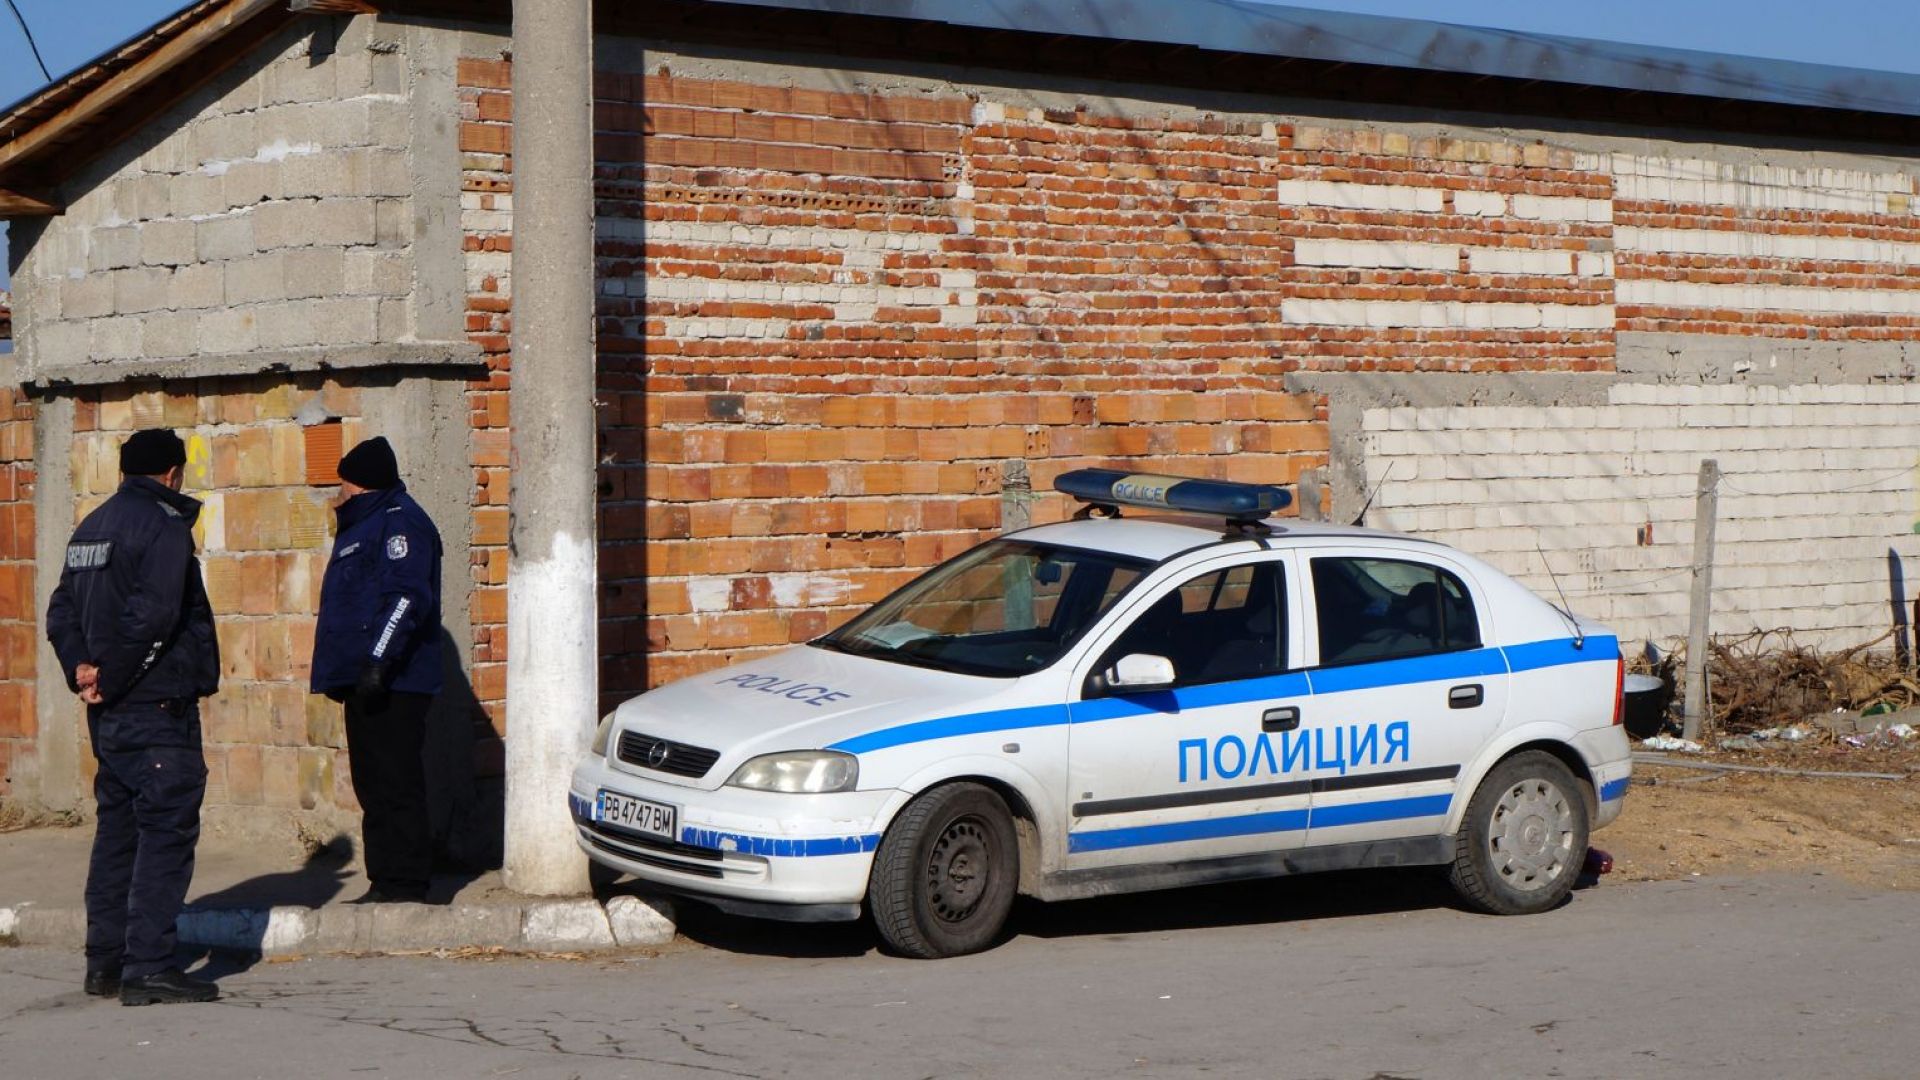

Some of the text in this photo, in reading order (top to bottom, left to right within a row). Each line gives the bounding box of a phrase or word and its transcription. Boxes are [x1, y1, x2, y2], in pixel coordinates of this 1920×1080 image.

[1116, 483, 1164, 501] POLICE
[373, 597, 410, 657] SECURITY POLICE
[714, 673, 852, 706] POLICE
[1178, 721, 1410, 783] ПОЛИЦИЯ
[604, 796, 671, 833] PB 4747 BM
